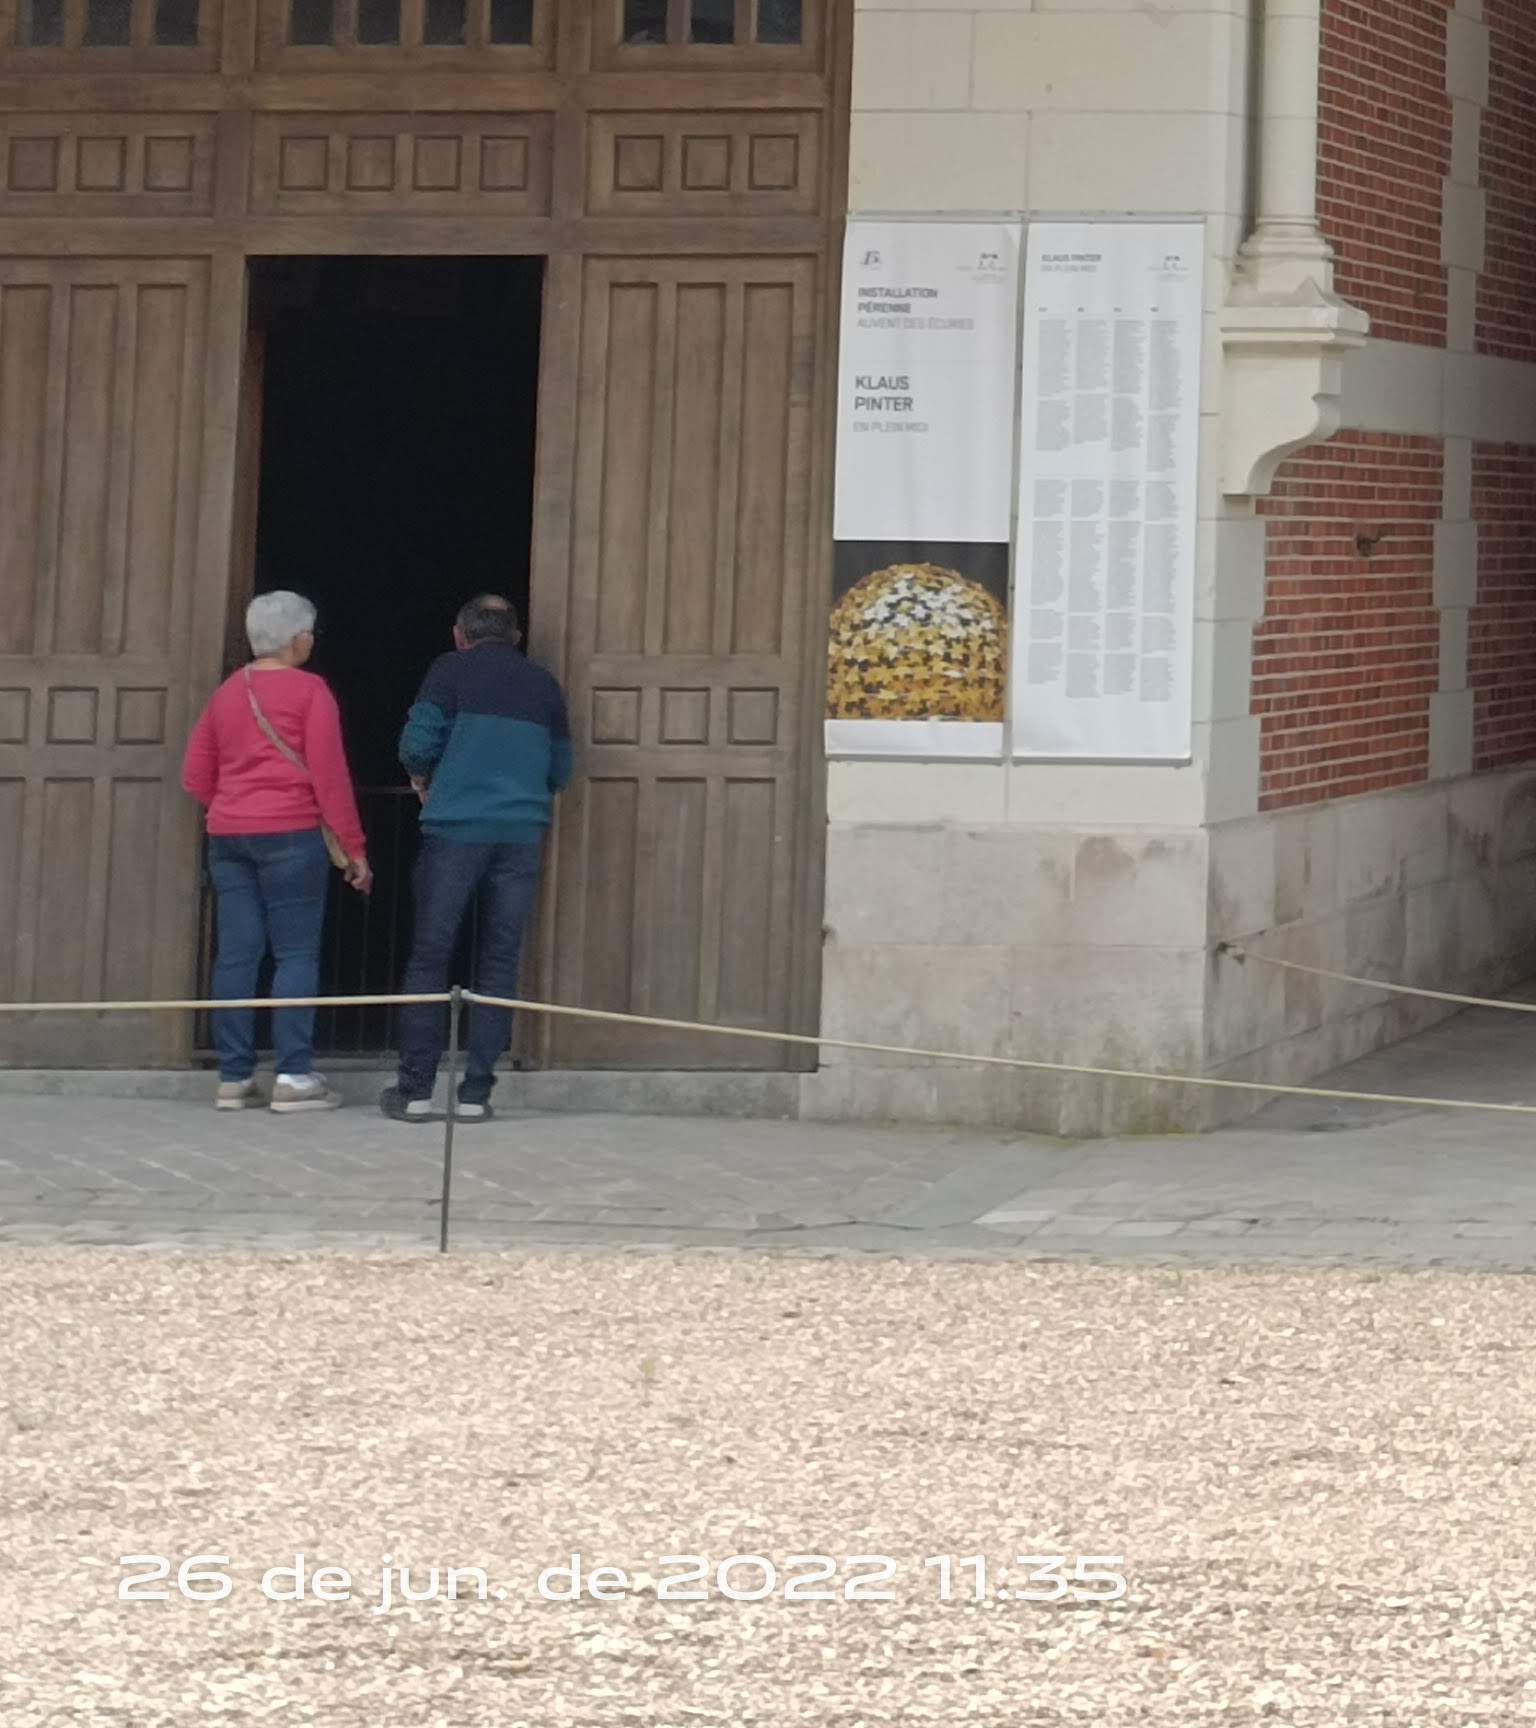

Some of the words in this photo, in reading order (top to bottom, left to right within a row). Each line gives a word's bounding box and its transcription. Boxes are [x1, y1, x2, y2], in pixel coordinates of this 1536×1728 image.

[857, 287, 938, 299] INSTALLATION
[857, 300, 911, 314] PÉRENNE
[855, 375, 910, 391] KLAUS
[854, 396, 914, 412] PINTER
